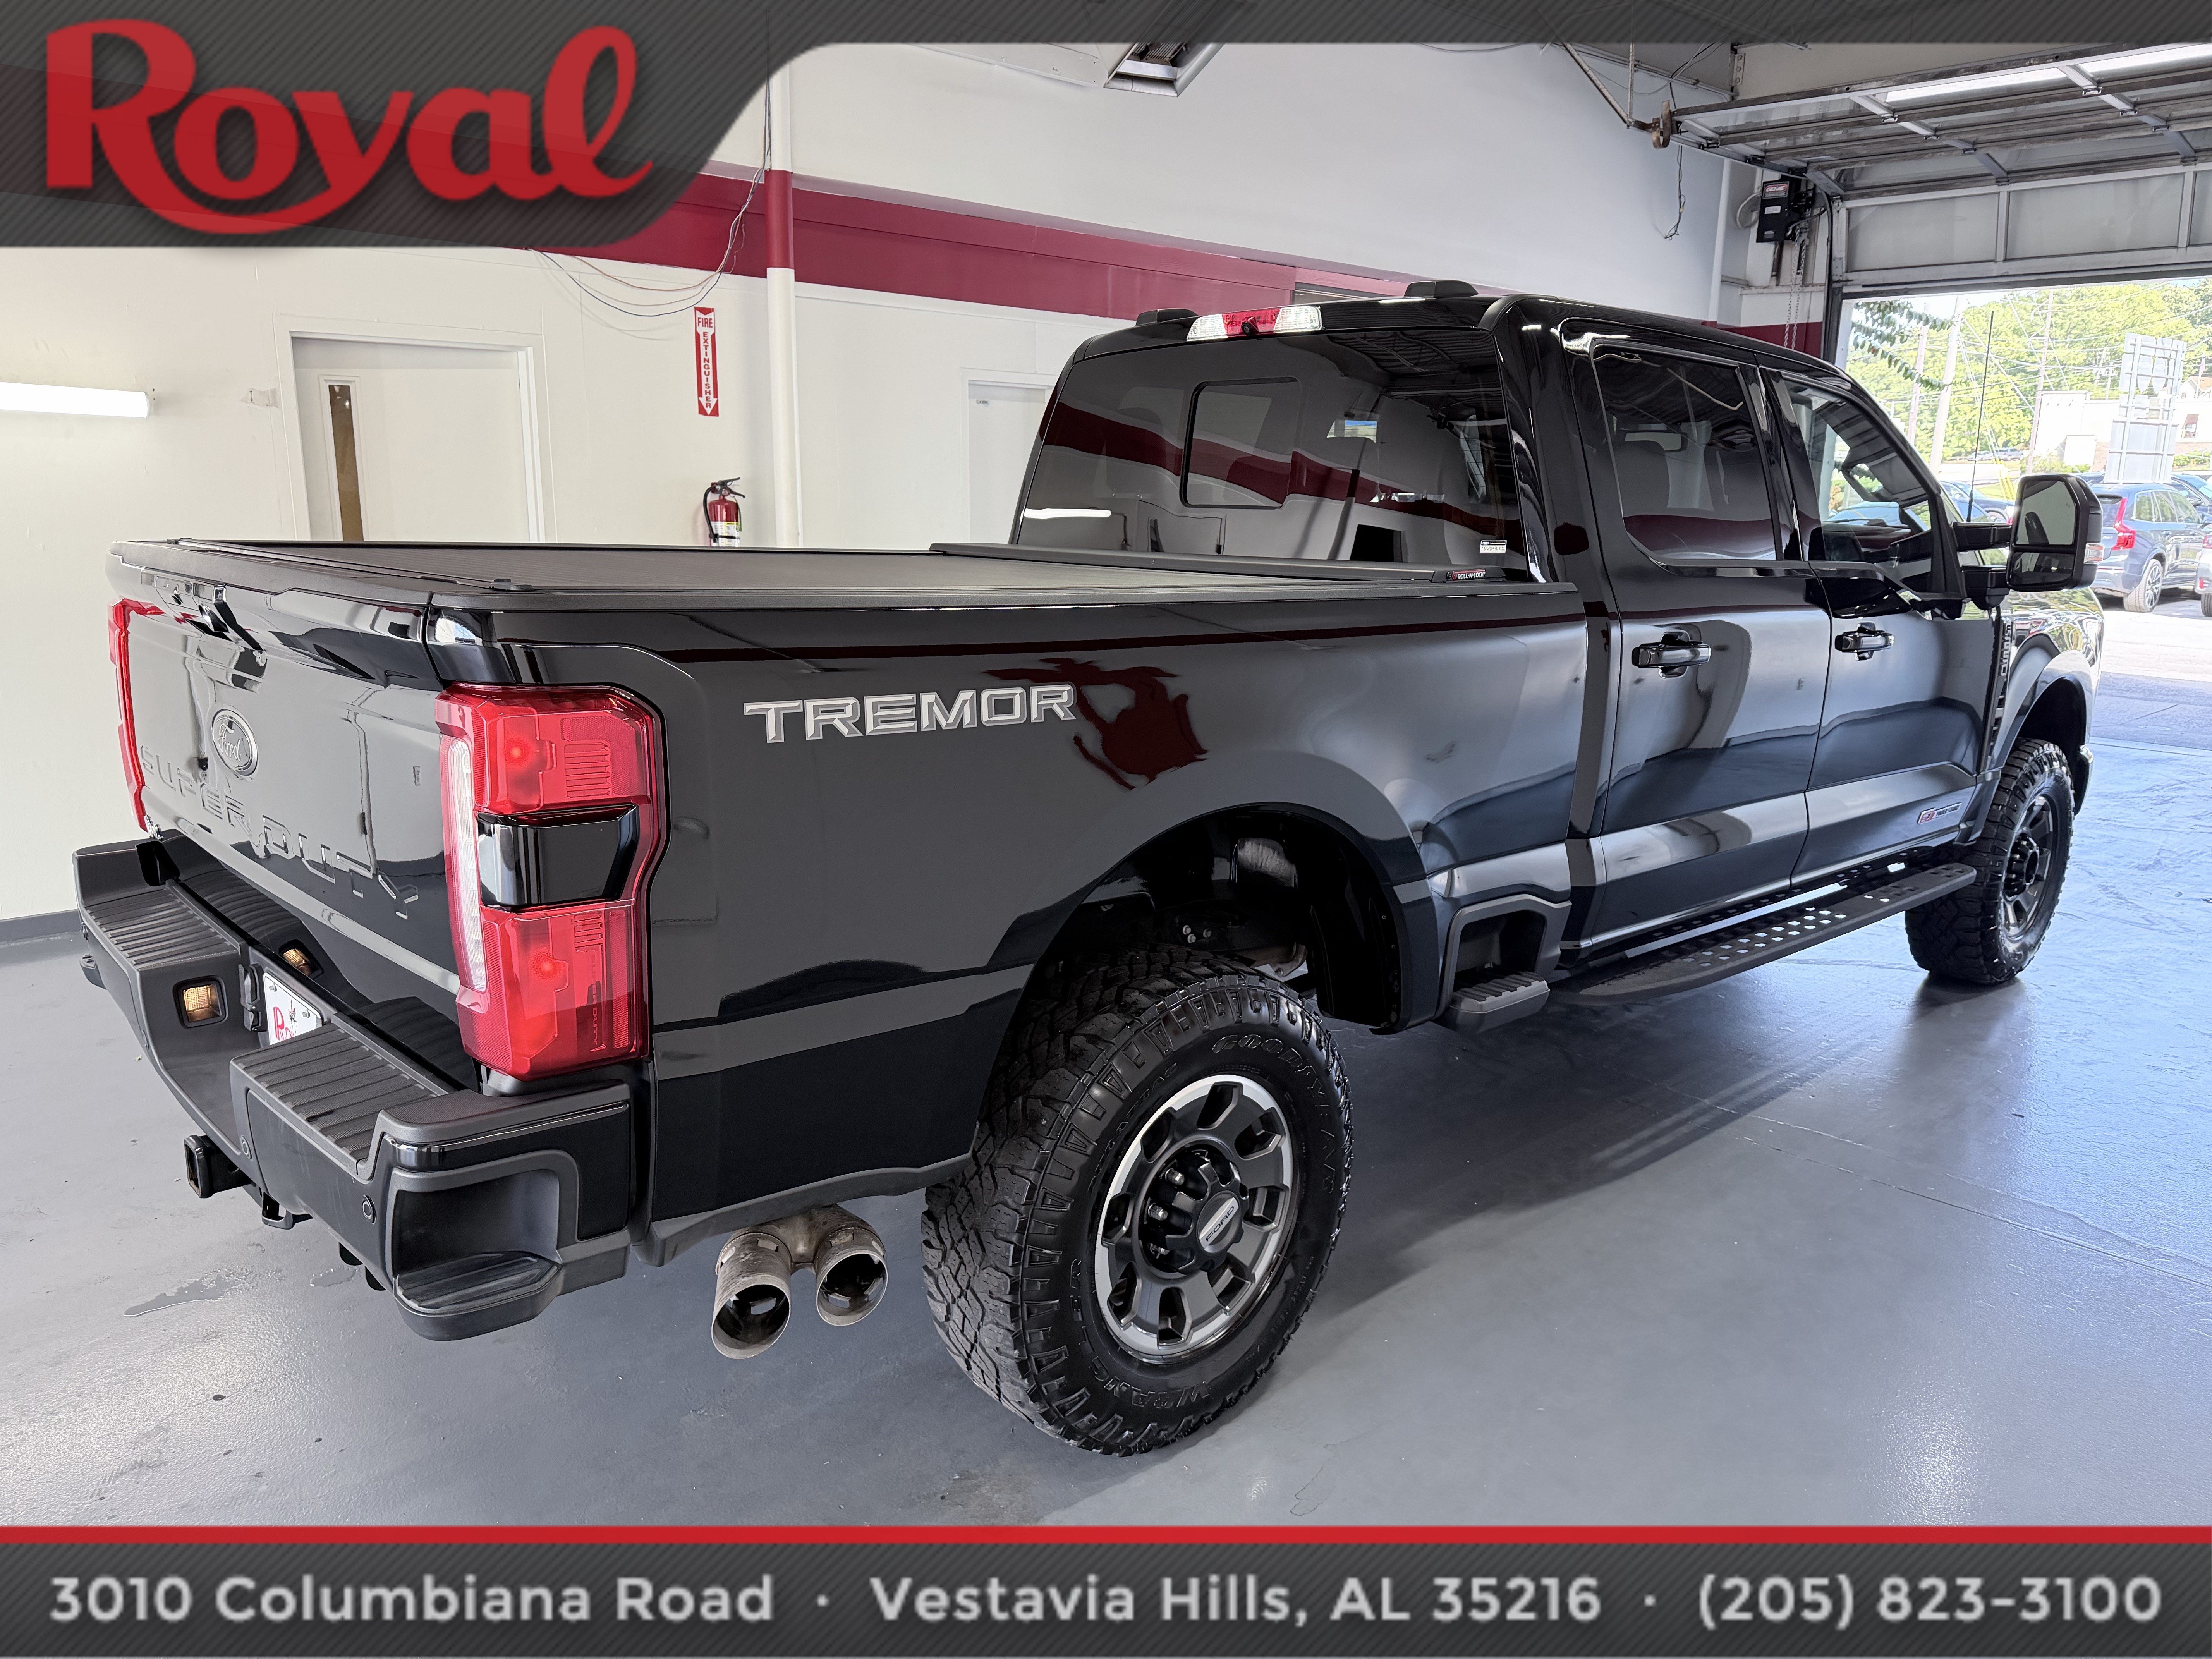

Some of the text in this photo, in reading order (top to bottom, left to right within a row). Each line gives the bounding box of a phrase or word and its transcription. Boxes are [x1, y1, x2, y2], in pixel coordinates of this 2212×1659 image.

[697, 317, 713, 328] FIRE
[703, 331, 711, 408] EXTINGUISHER
[218, 723, 242, 762] Ford
[743, 681, 1077, 743] TREMOR
[140, 745, 419, 920] SUPER DUTY
[1212, 1034, 1336, 1194] GOODYEAR
[1206, 1206, 1234, 1242] FORD
